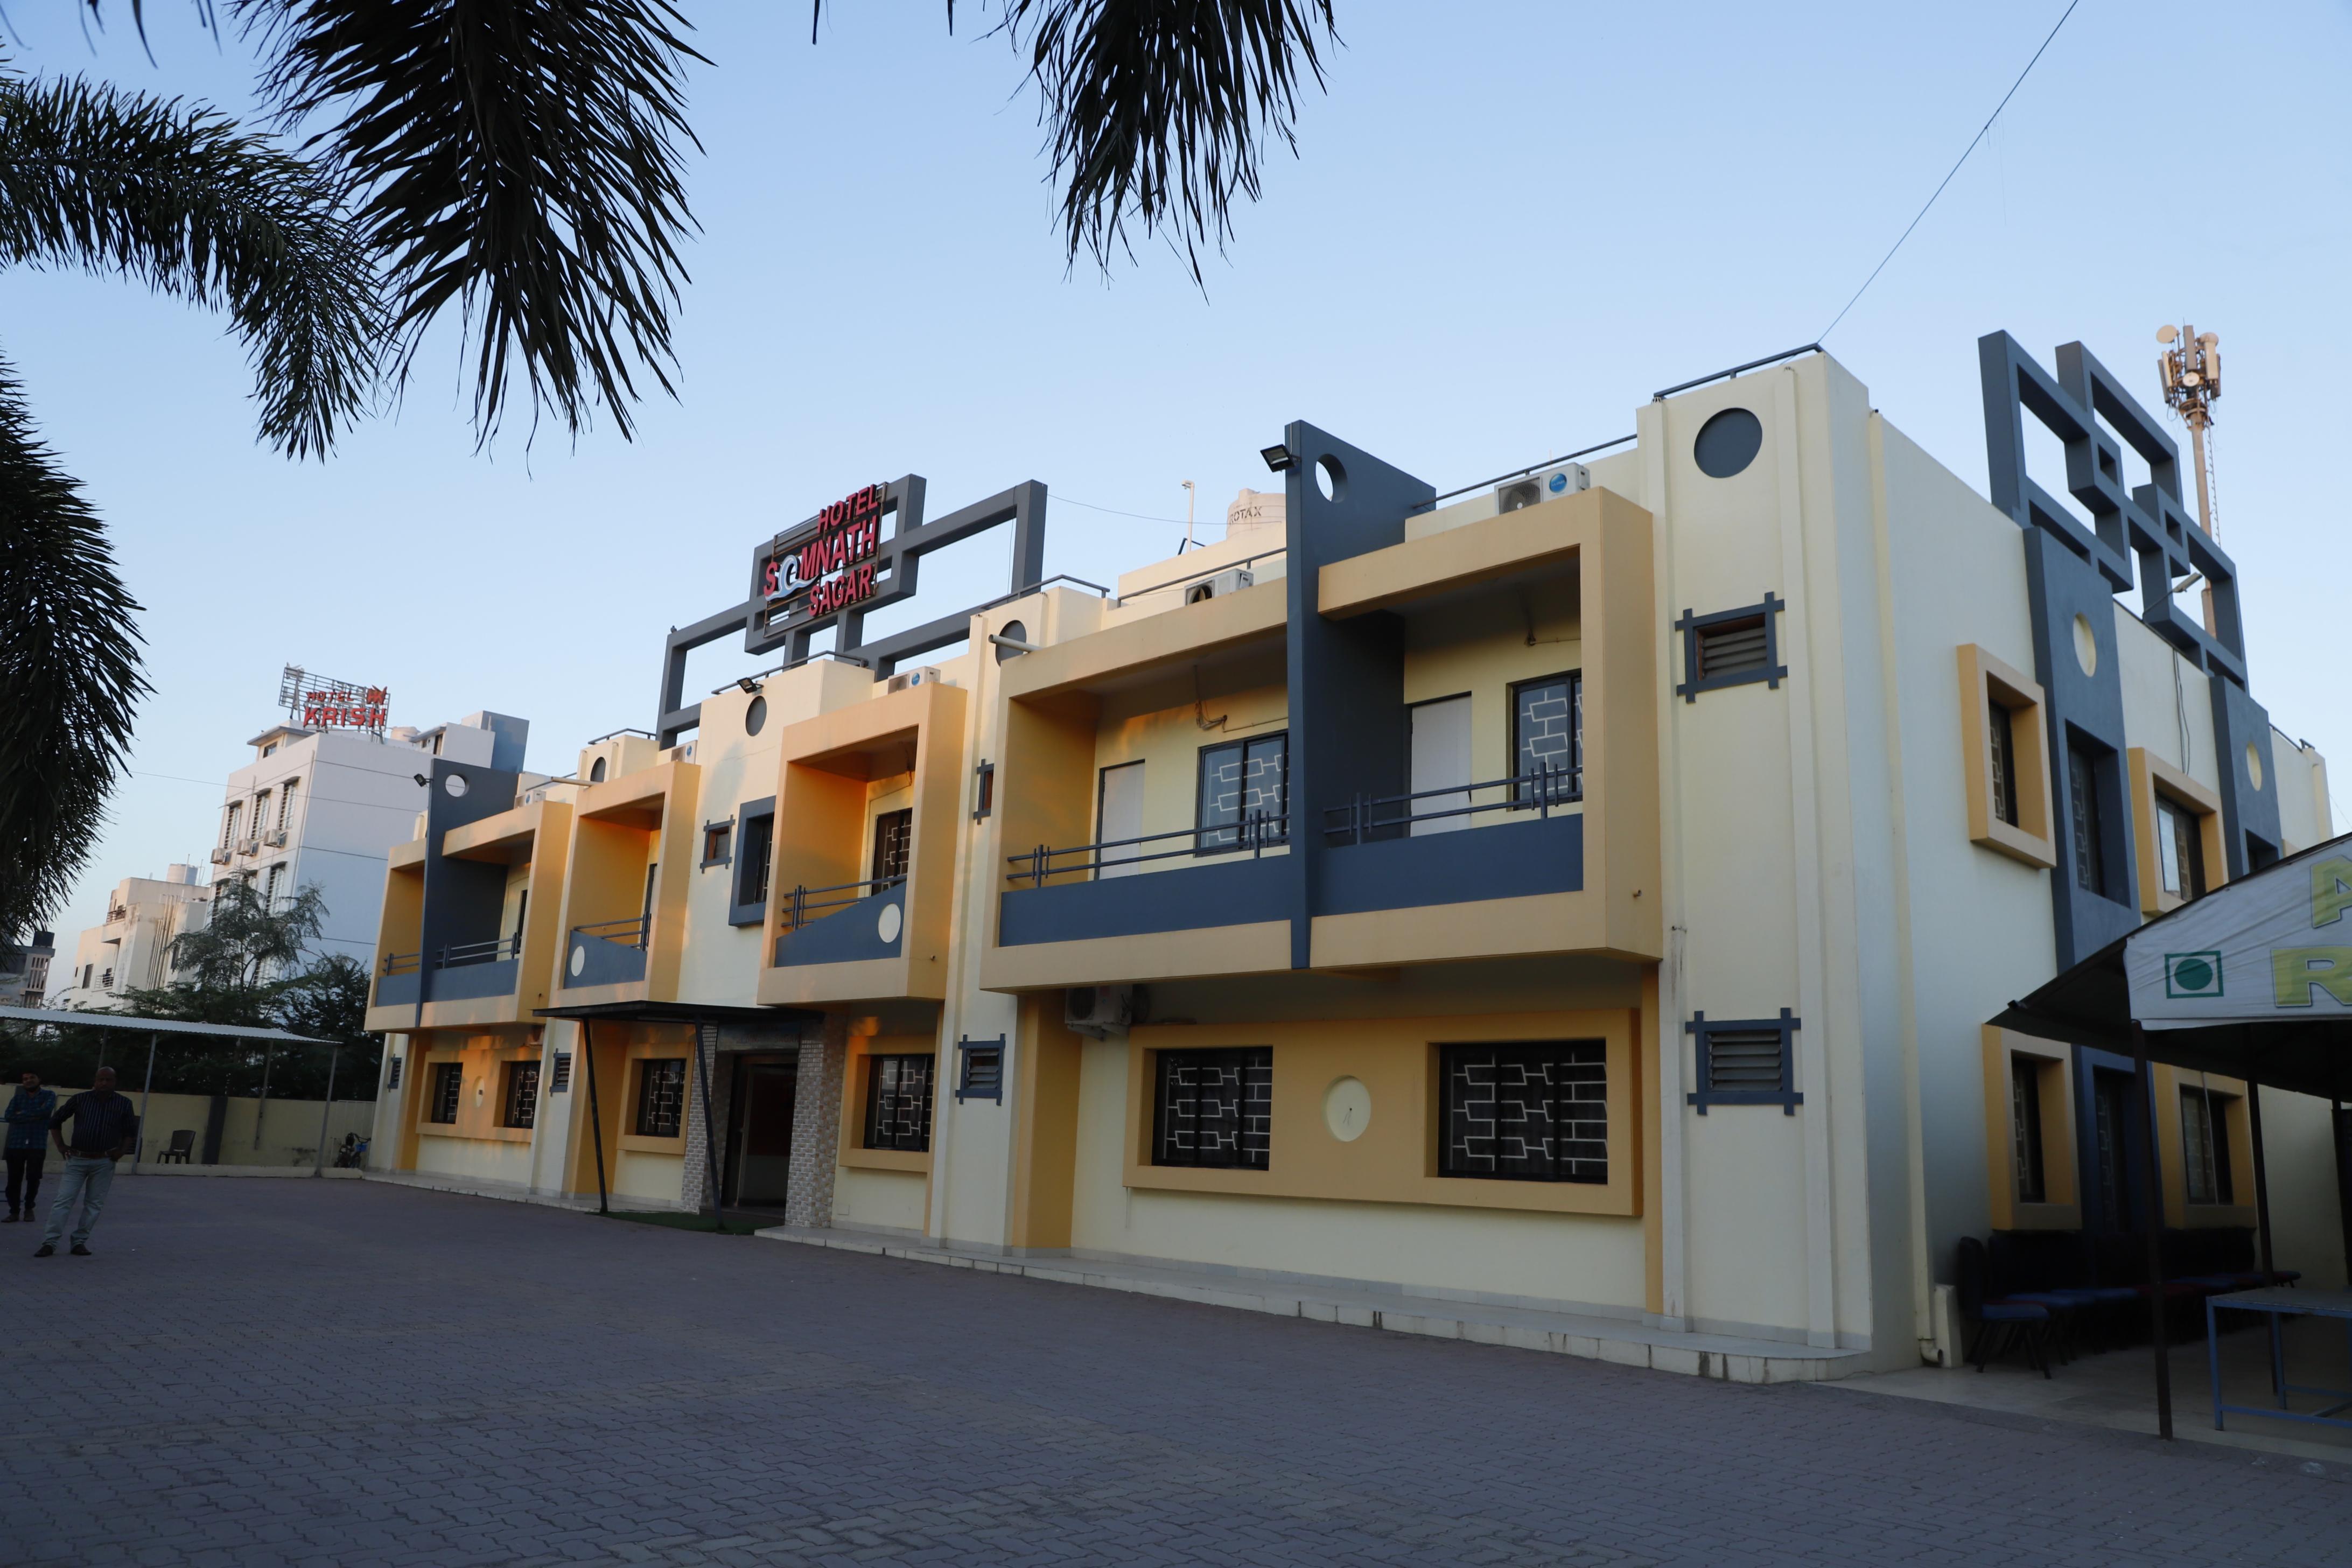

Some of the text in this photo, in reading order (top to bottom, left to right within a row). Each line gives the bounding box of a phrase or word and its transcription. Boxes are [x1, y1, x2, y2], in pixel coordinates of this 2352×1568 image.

[817, 484, 879, 534] HOTEL
[763, 515, 879, 601] SOMNATH
[808, 564, 873, 617] SAGAR
[303, 706, 386, 727] KRISH
[306, 690, 354, 703] HOTEL
